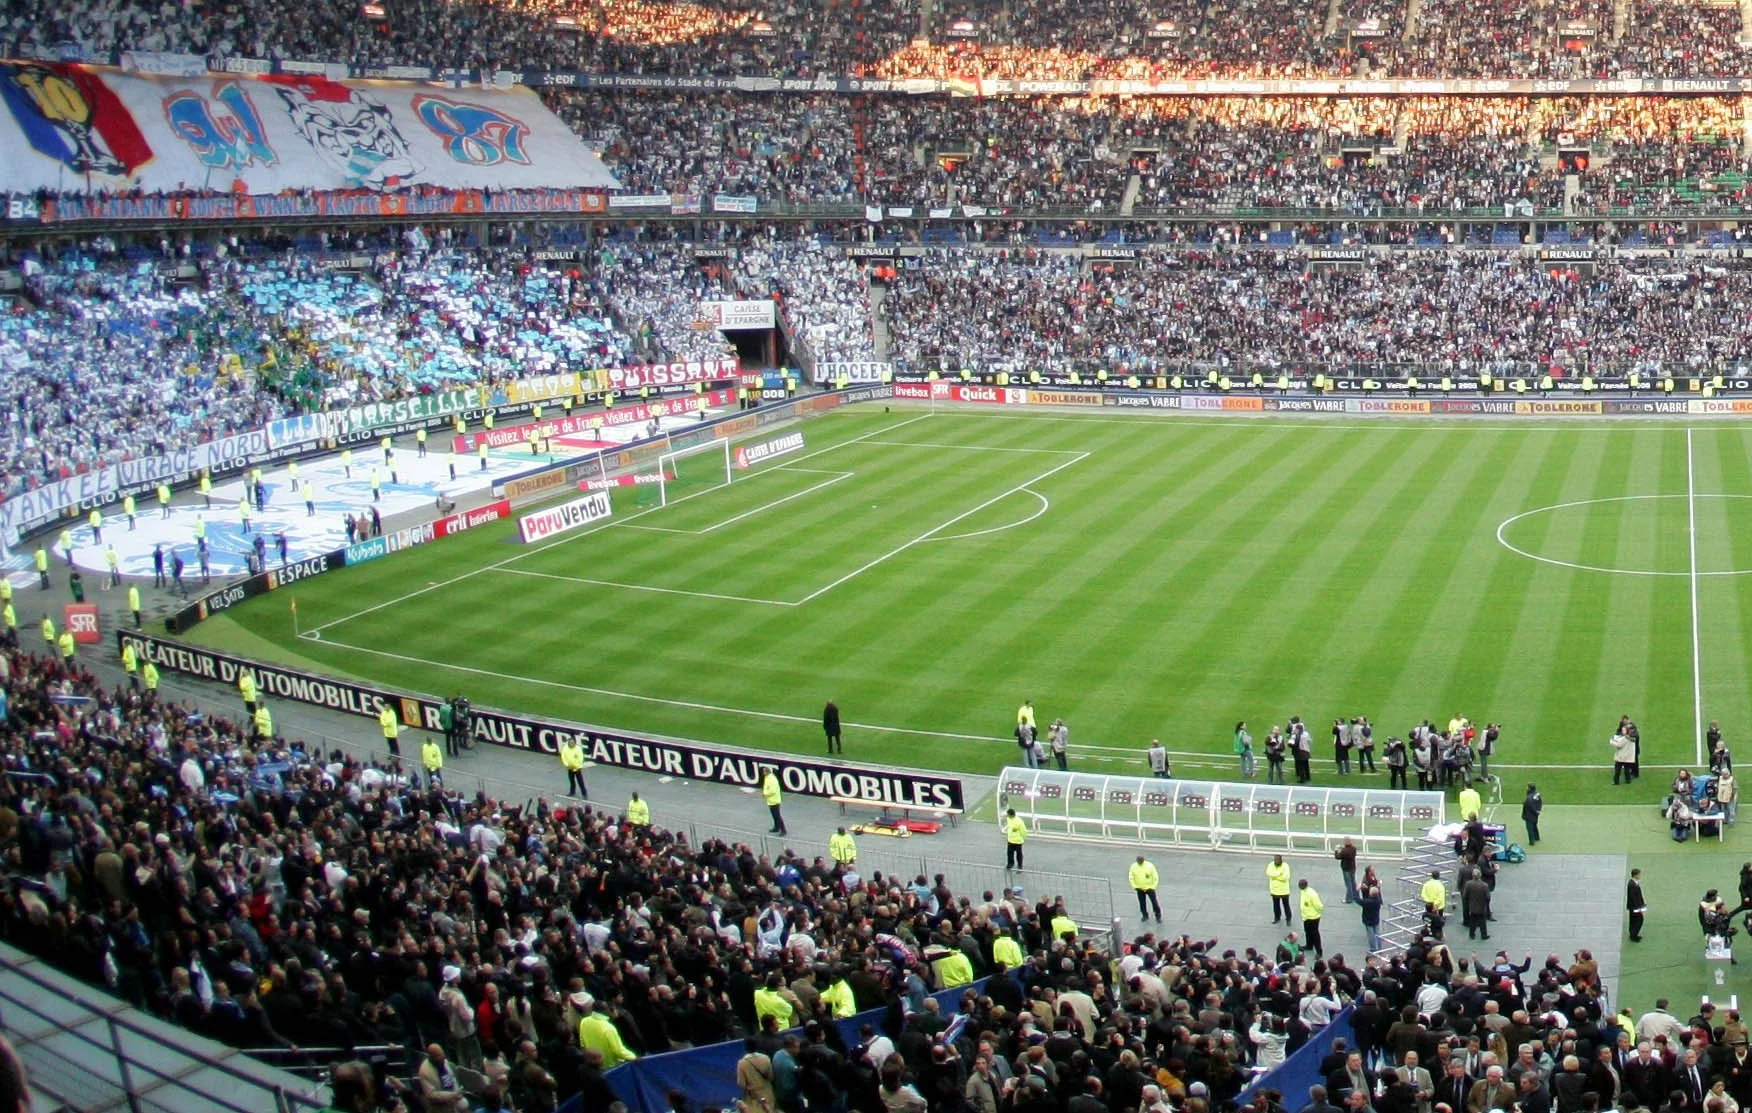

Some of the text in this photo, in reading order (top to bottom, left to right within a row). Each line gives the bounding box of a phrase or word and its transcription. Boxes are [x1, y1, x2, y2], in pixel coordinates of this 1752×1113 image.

[599, 76, 738, 89] Les Partenaires du Stade de Fran
[1676, 80, 1730, 91] RENAULT
[410, 92, 532, 166] 87
[537, 251, 576, 260] RENAULT
[696, 249, 729, 258] RENAULT
[855, 247, 895, 257] RENAULT
[1321, 249, 1363, 258] RENAULT
[1551, 250, 1594, 259] RENAULT
[609, 359, 739, 388] PUISSANT
[933, 383, 950, 394] SFR
[1338, 380, 1382, 390] CLO
[588, 389, 621, 401] CLO
[895, 385, 929, 398] livebox
[960, 387, 997, 402] Quick
[1038, 392, 1100, 404] TOBLERONE
[1152, 395, 1181, 407] VABRE
[1194, 397, 1259, 409] TOBLERONE
[350, 387, 480, 431] MARSEILLE
[1314, 399, 1345, 410] VABRE
[1361, 399, 1427, 411] TOBLERONE
[1483, 401, 1515, 413] VABRE
[1530, 401, 1599, 413] TOBLERONE
[1657, 401, 1689, 412] VABRE
[606, 401, 684, 428] Visitez le de
[339, 431, 372, 445] CLIO
[487, 430, 519, 447] Visitez
[563, 423, 574, 435] de
[213, 456, 248, 475] CLIO
[0, 470, 111, 525] YANKEE
[120, 451, 200, 482] VIRAGE
[208, 433, 265, 471] NORD
[587, 478, 620, 489] livebox
[81, 493, 116, 511] CLIO
[526, 494, 609, 541] ParuVendu
[346, 543, 384, 563] Kubota
[279, 557, 328, 586] ESPACE
[70, 613, 97, 633] SFR
[221, 660, 386, 716] D'AUTOMOBILES
[425, 706, 532, 747] RAULT
[539, 730, 684, 775] CRÉATEUR
[692, 753, 953, 808] D'AUTOMOBILES
